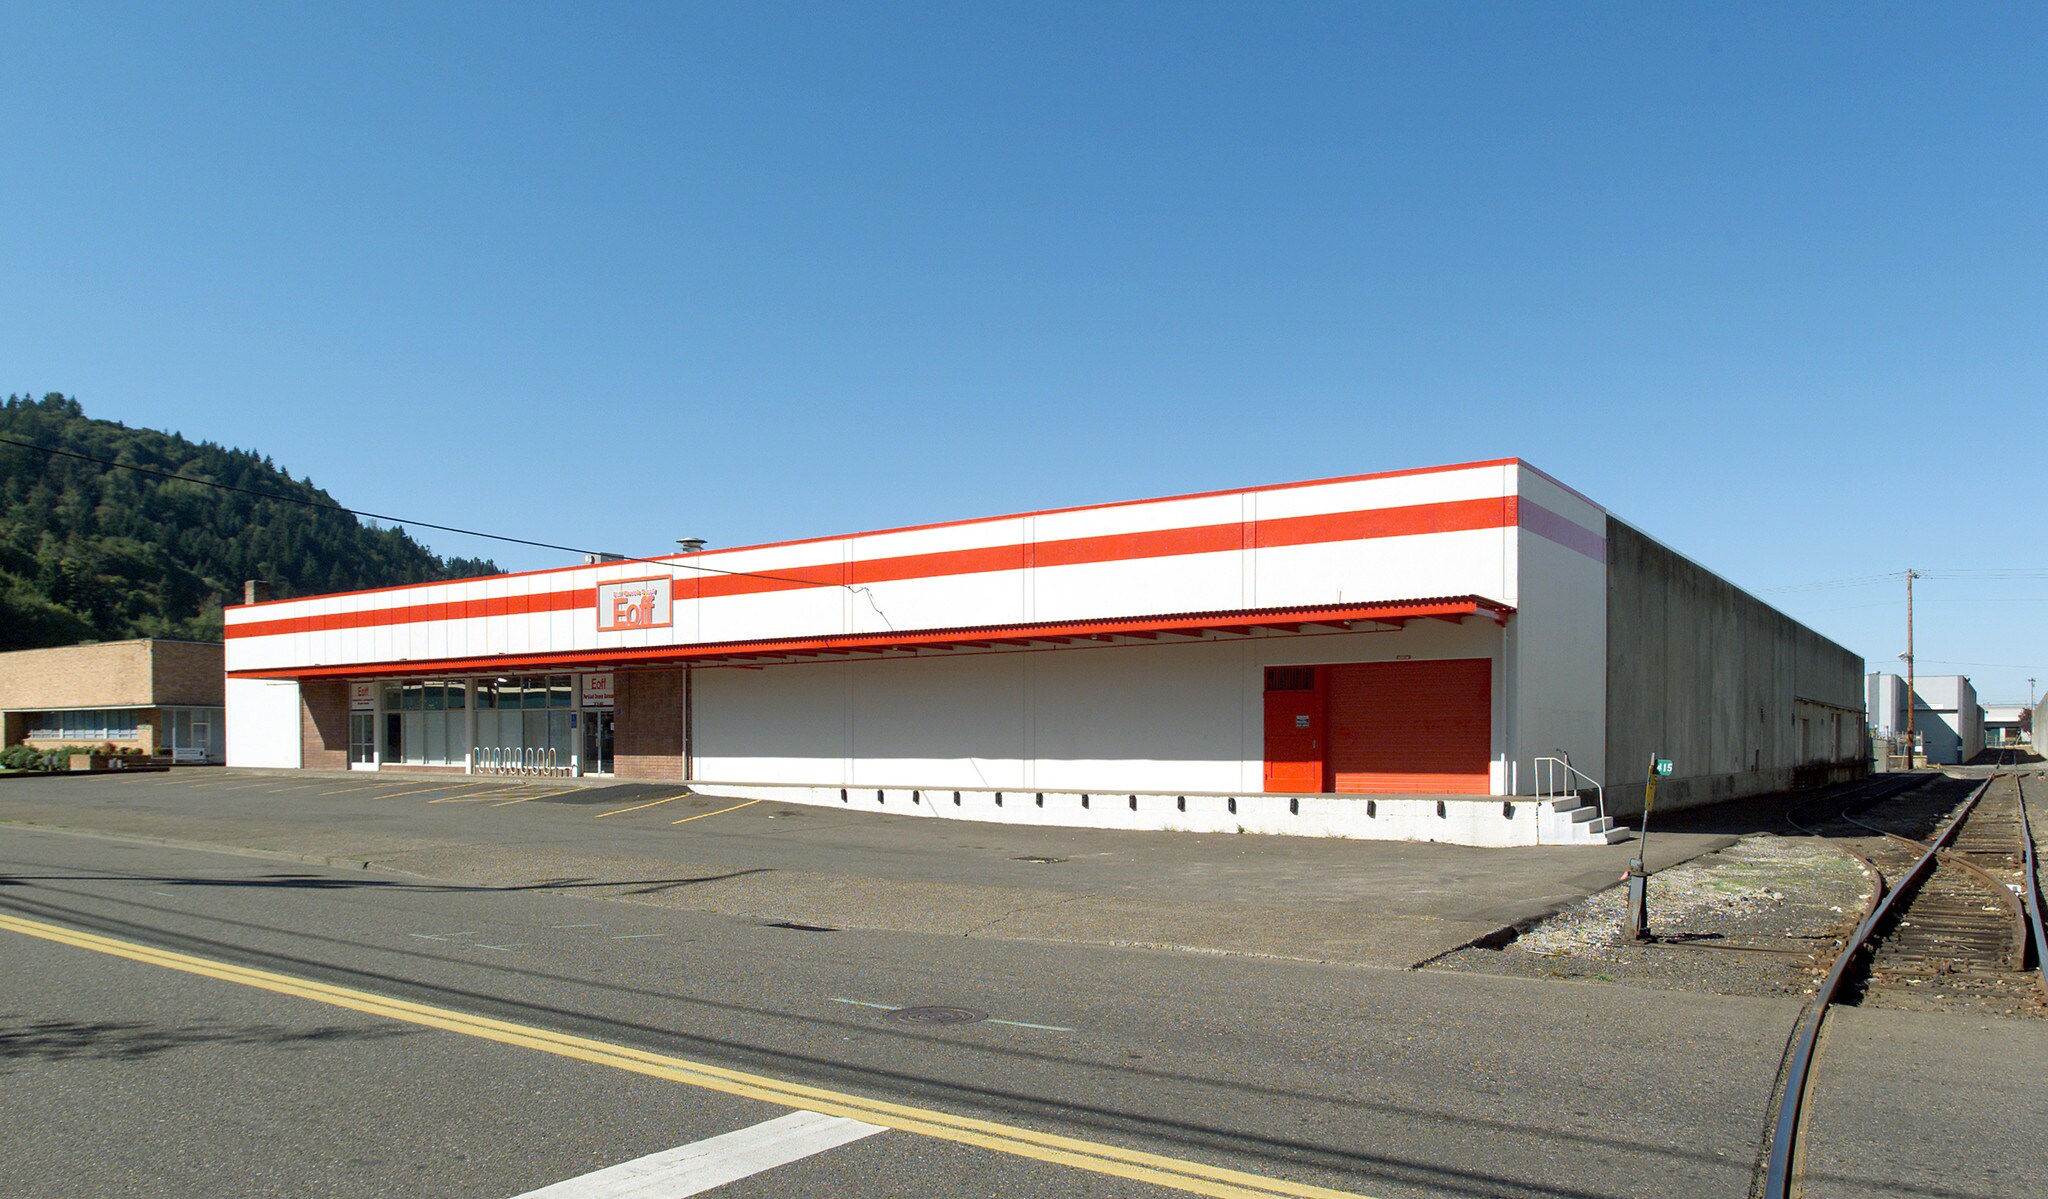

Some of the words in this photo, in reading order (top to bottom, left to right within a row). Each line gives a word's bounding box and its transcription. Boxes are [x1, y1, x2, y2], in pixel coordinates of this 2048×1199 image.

[613, 596, 655, 627] Eoff
[592, 677, 607, 689] Eoff
[1657, 763, 1673, 772] 415
